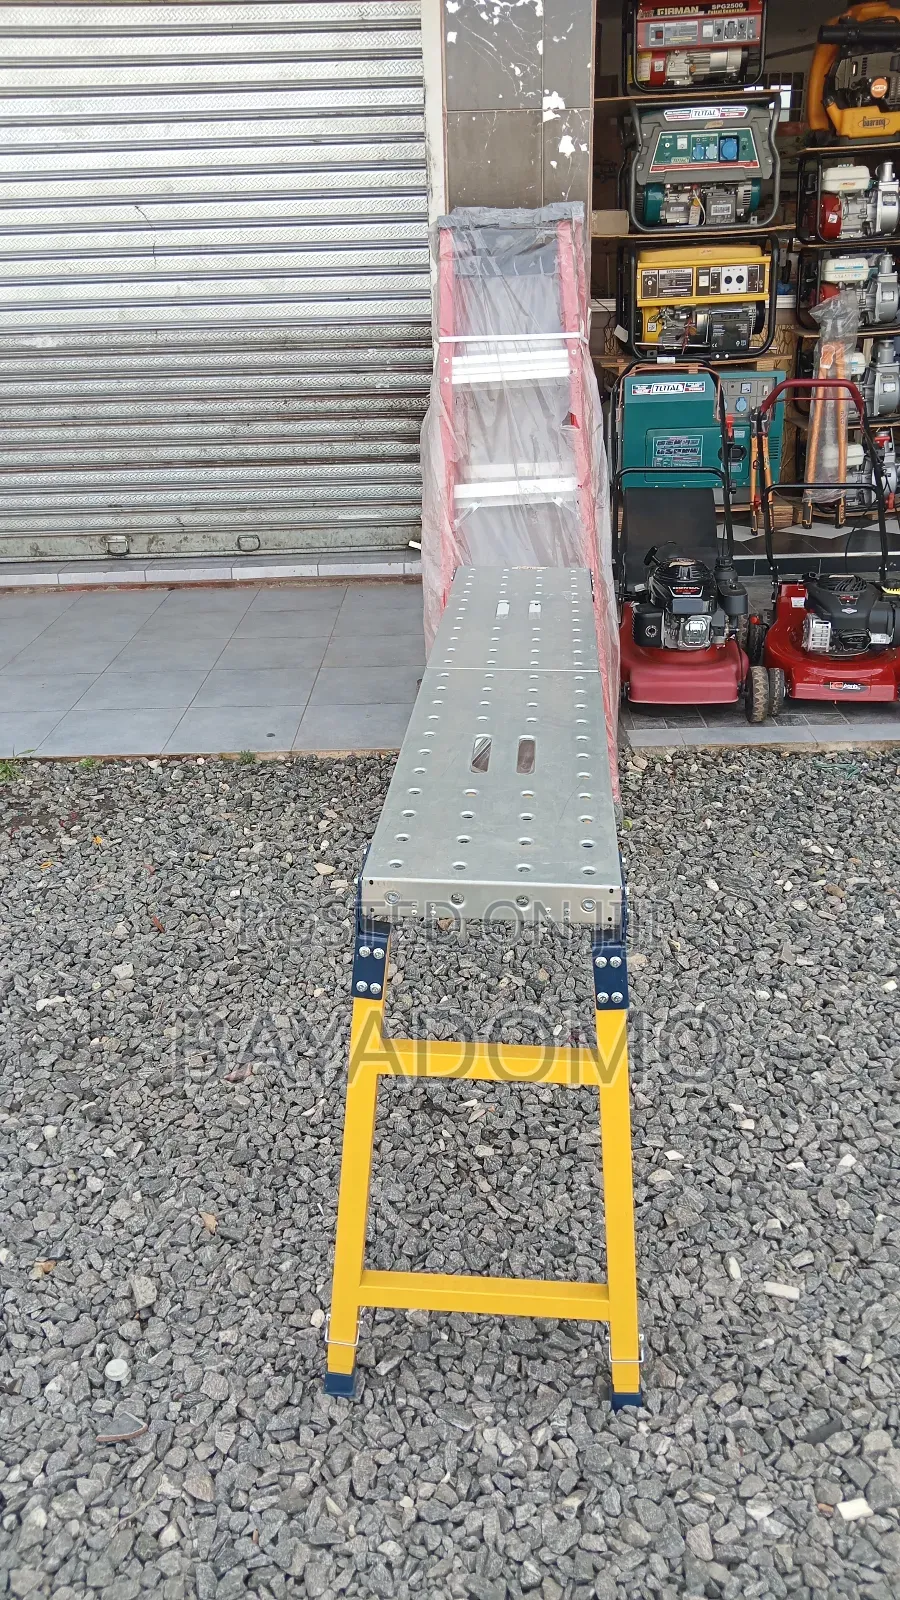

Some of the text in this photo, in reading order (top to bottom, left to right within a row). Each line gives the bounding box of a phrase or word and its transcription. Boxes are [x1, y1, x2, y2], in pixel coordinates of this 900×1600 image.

[711, 2, 744, 10] SPG2500
[657, 6, 699, 16] FIRMAN
[655, 384, 681, 392] TOTAL
